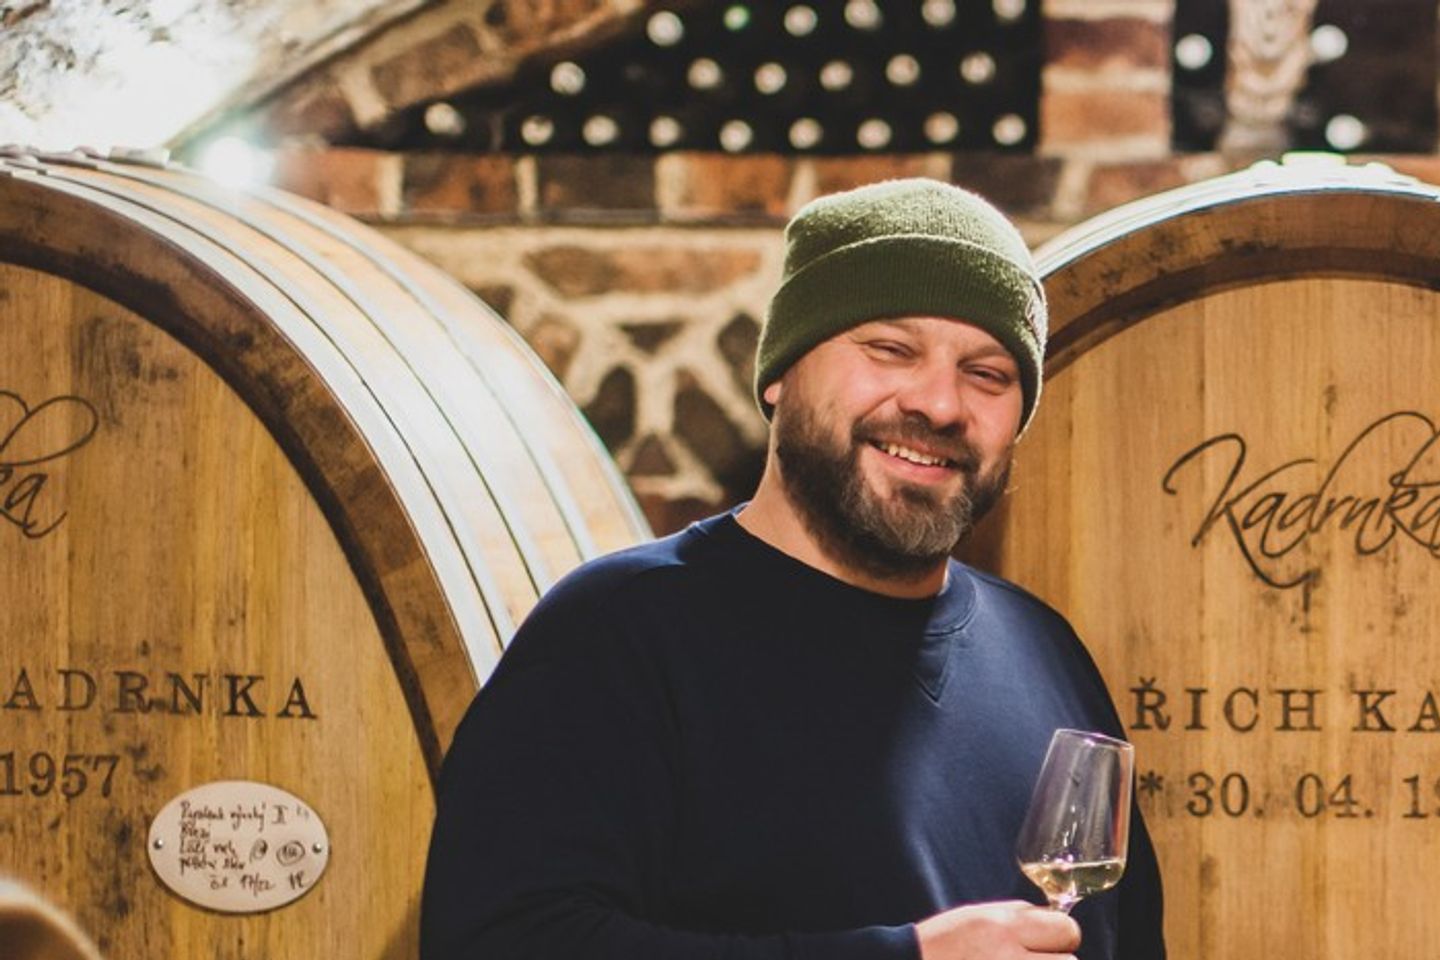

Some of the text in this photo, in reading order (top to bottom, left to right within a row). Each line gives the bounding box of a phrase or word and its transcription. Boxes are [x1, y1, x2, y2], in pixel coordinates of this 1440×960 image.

[1, 665, 318, 720] ADRNKA
[0, 750, 121, 798] 1957
[1185, 771, 1265, 819] 30.
[1295, 773, 1376, 819] 04.
